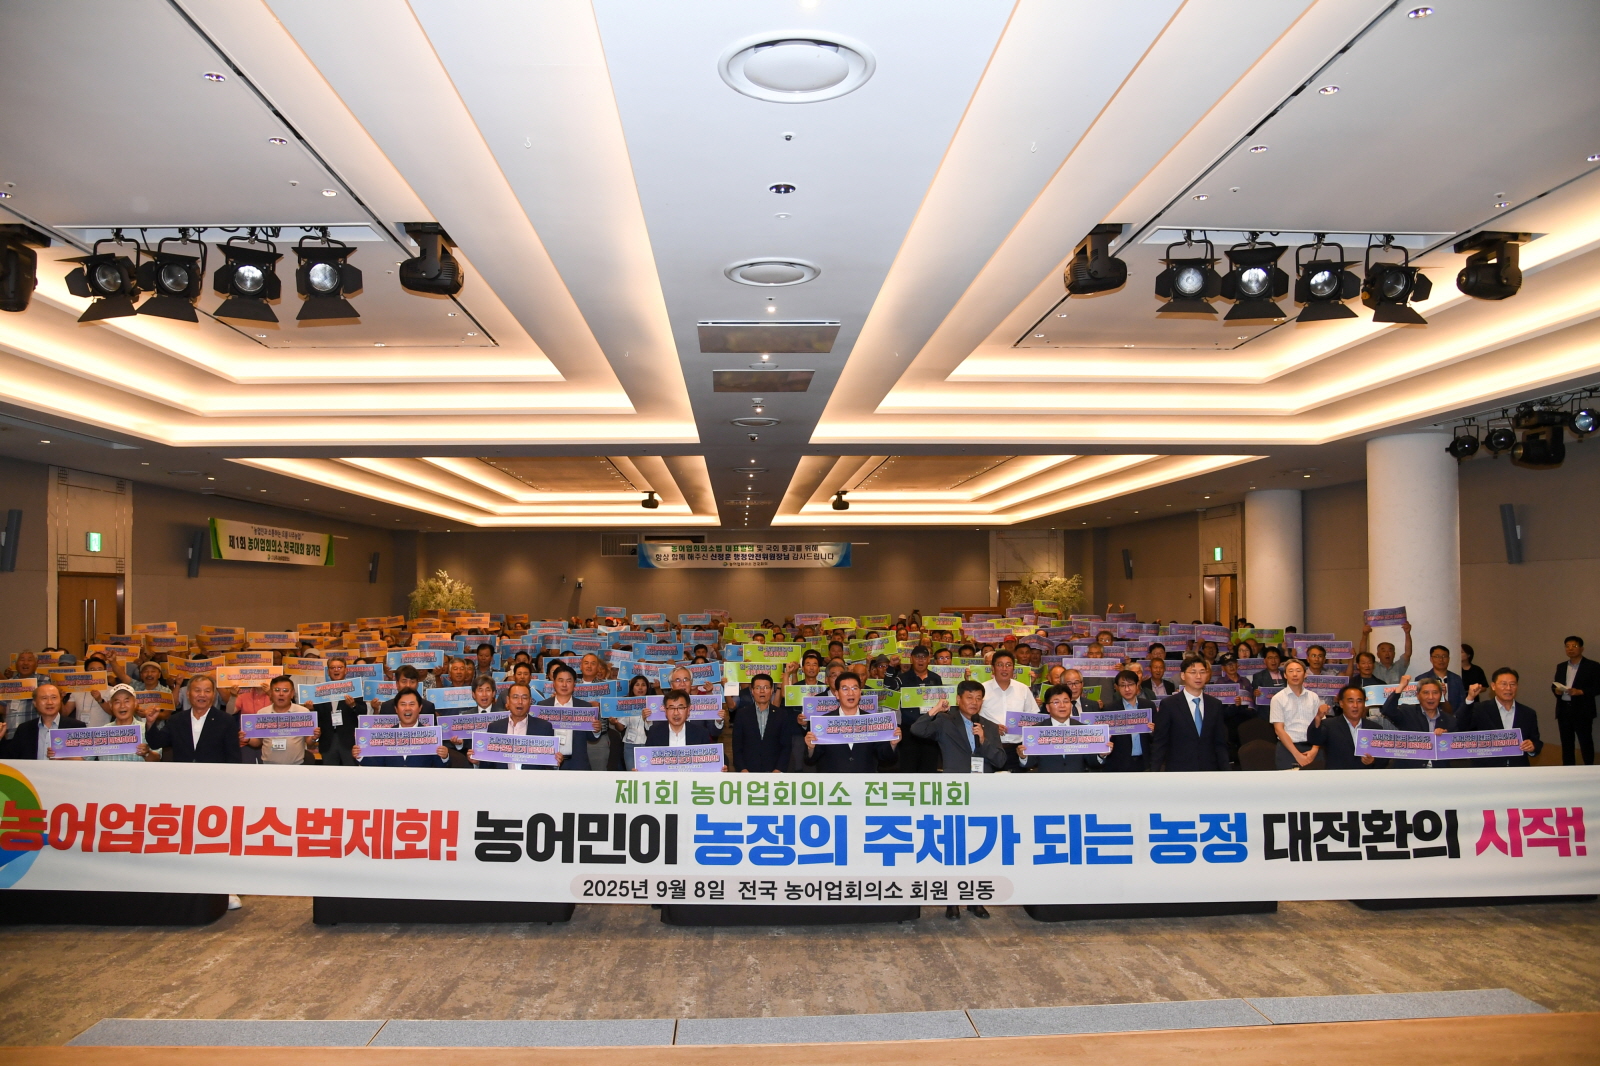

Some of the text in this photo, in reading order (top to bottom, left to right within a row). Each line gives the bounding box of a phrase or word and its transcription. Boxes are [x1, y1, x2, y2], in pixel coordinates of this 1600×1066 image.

[228, 535, 321, 557] 제1회 농어업회의소 전국대회 참가단
[655, 552, 834, 561] 항상 함께 해주신 신정훈 행정안전위원장님 감사드립니다
[804, 544, 818, 552] 위해
[617, 781, 970, 806] 제1회 농어업회의소 전국대회
[0, 803, 1587, 867] 농어업회의소법제화! 농어민이 농정의 주체가 되는 농정 대전환의 시작!
[585, 881, 995, 901] 2025년 9월 8일 전국 농어업회의소 회원 일동
